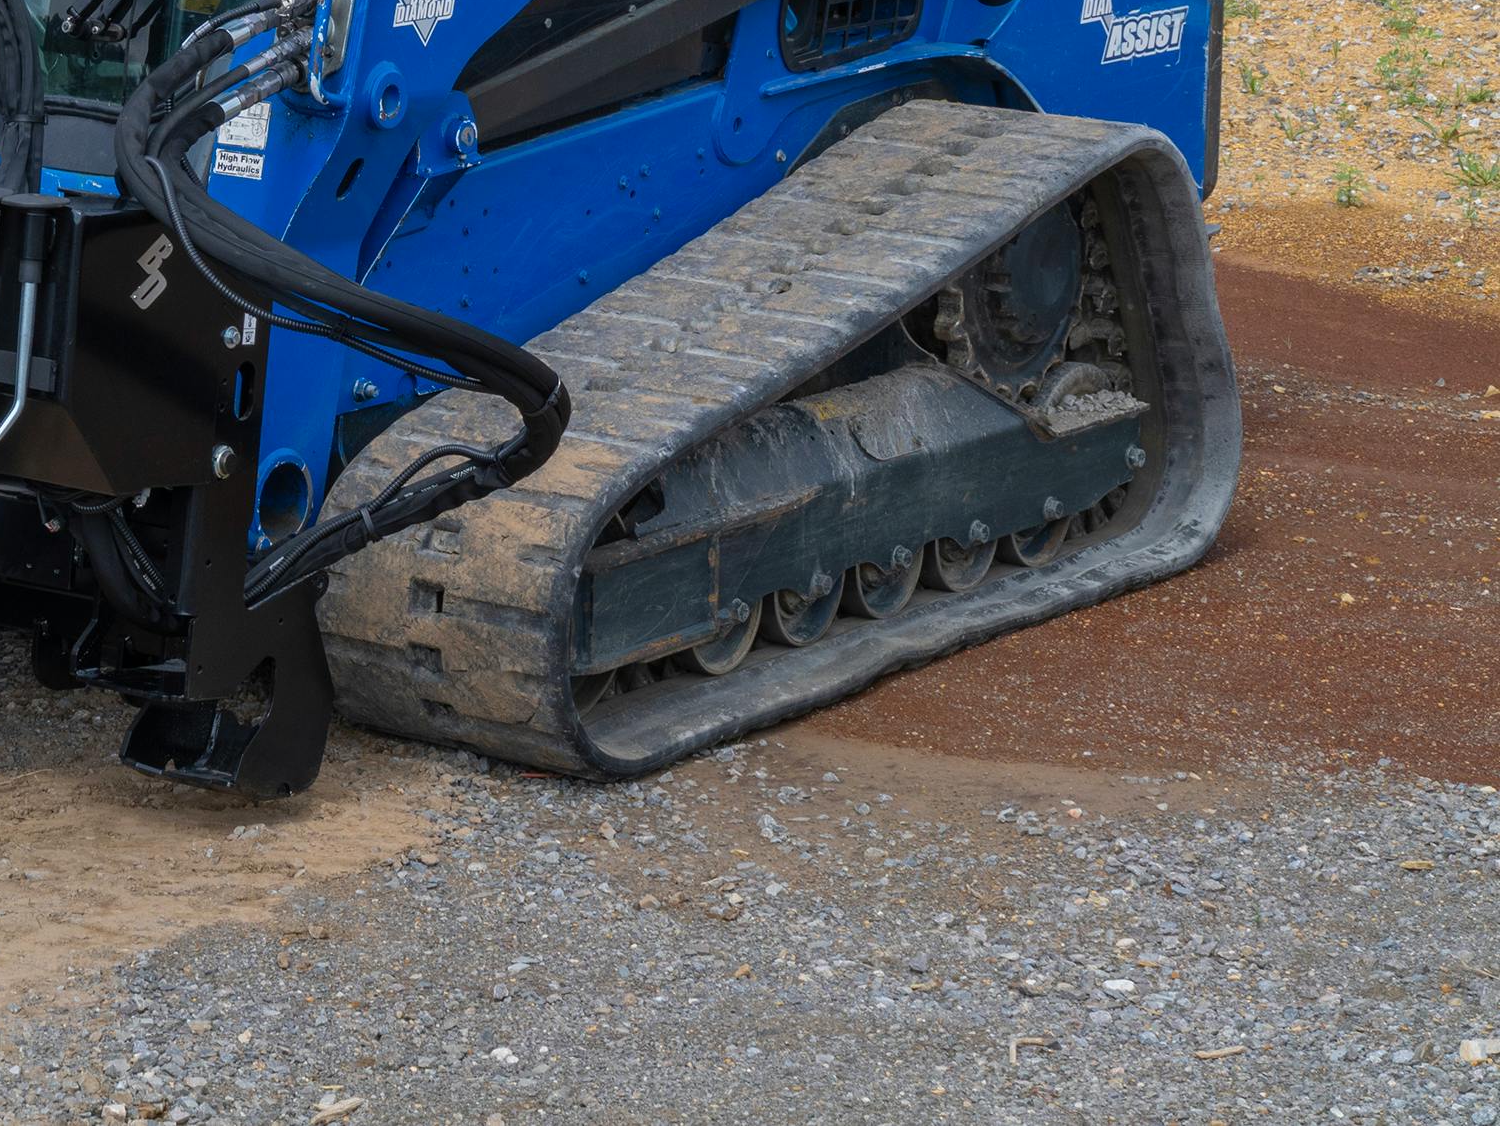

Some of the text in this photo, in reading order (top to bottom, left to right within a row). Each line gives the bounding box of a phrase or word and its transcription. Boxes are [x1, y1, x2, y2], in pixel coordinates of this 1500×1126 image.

[1105, 12, 1185, 59] ASSIST
[219, 152, 238, 163] High
[217, 161, 260, 174] Hydraulics
